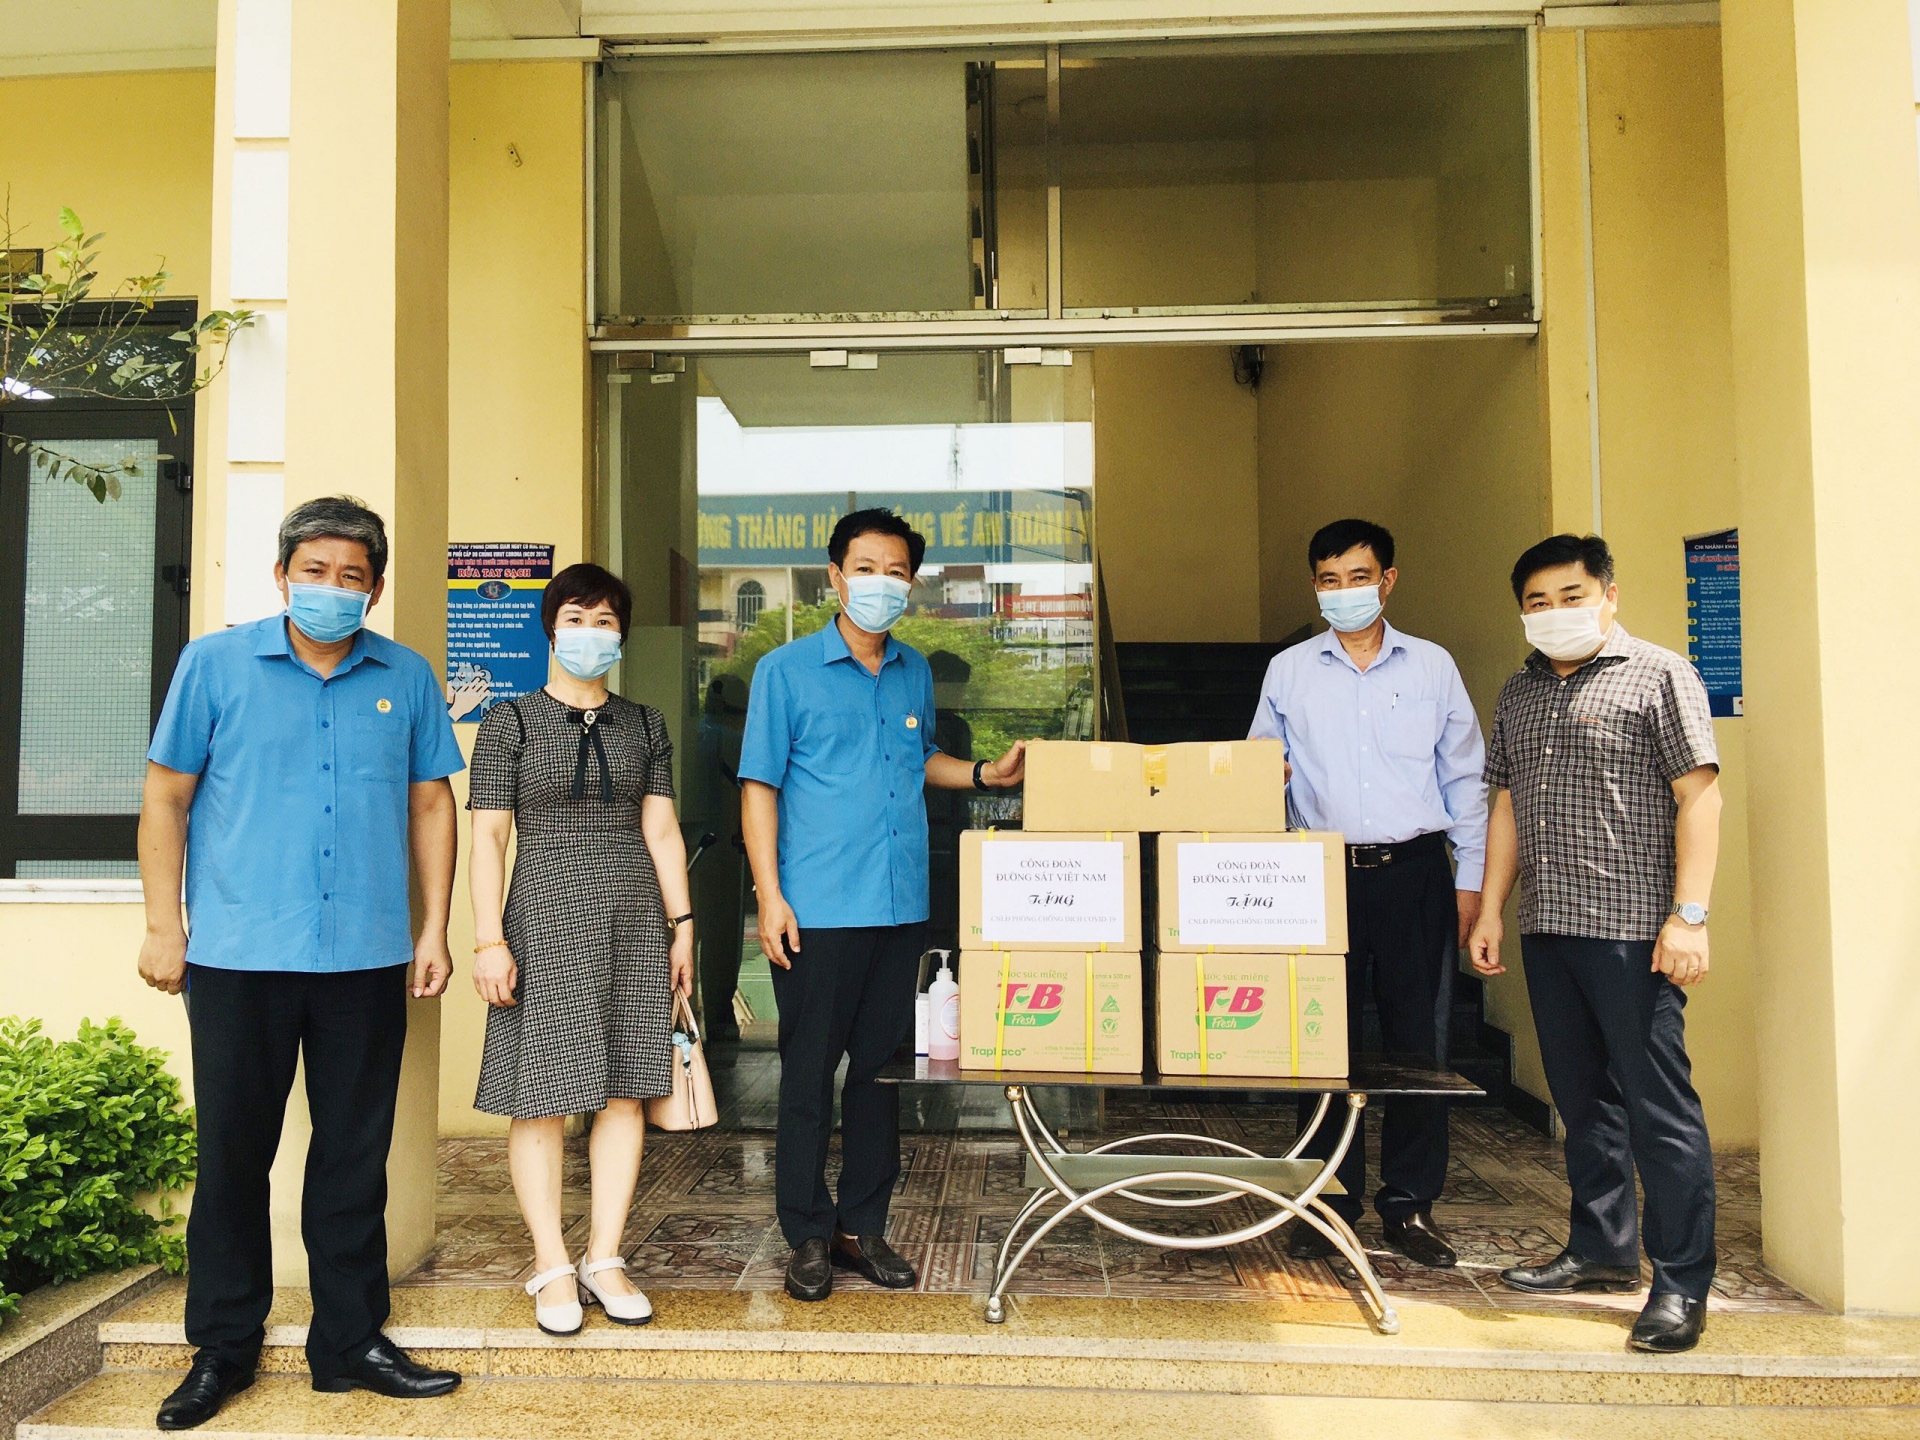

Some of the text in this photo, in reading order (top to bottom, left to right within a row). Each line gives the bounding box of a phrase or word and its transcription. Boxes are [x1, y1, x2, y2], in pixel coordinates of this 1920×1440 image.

[457, 565, 532, 580] RỬA TAY SẠCH
[1020, 858, 1082, 868] CÔNG ĐOÀN
[1217, 860, 1280, 870] CÔNG ĐOÀN
[1056, 871, 1081, 883] VIỆT
[1082, 873, 1106, 882] NAM
[1254, 873, 1279, 886] VIỆT
[1281, 875, 1306, 884] NAM
[1028, 891, 1075, 907] TẶNG
[1226, 893, 1274, 909] TẶNG
[1283, 917, 1318, 925] COVID-19
[1011, 1013, 1037, 1026] Fresh
[1211, 1016, 1237, 1029] Fresh
[1170, 1049, 1223, 1061] Traphco
